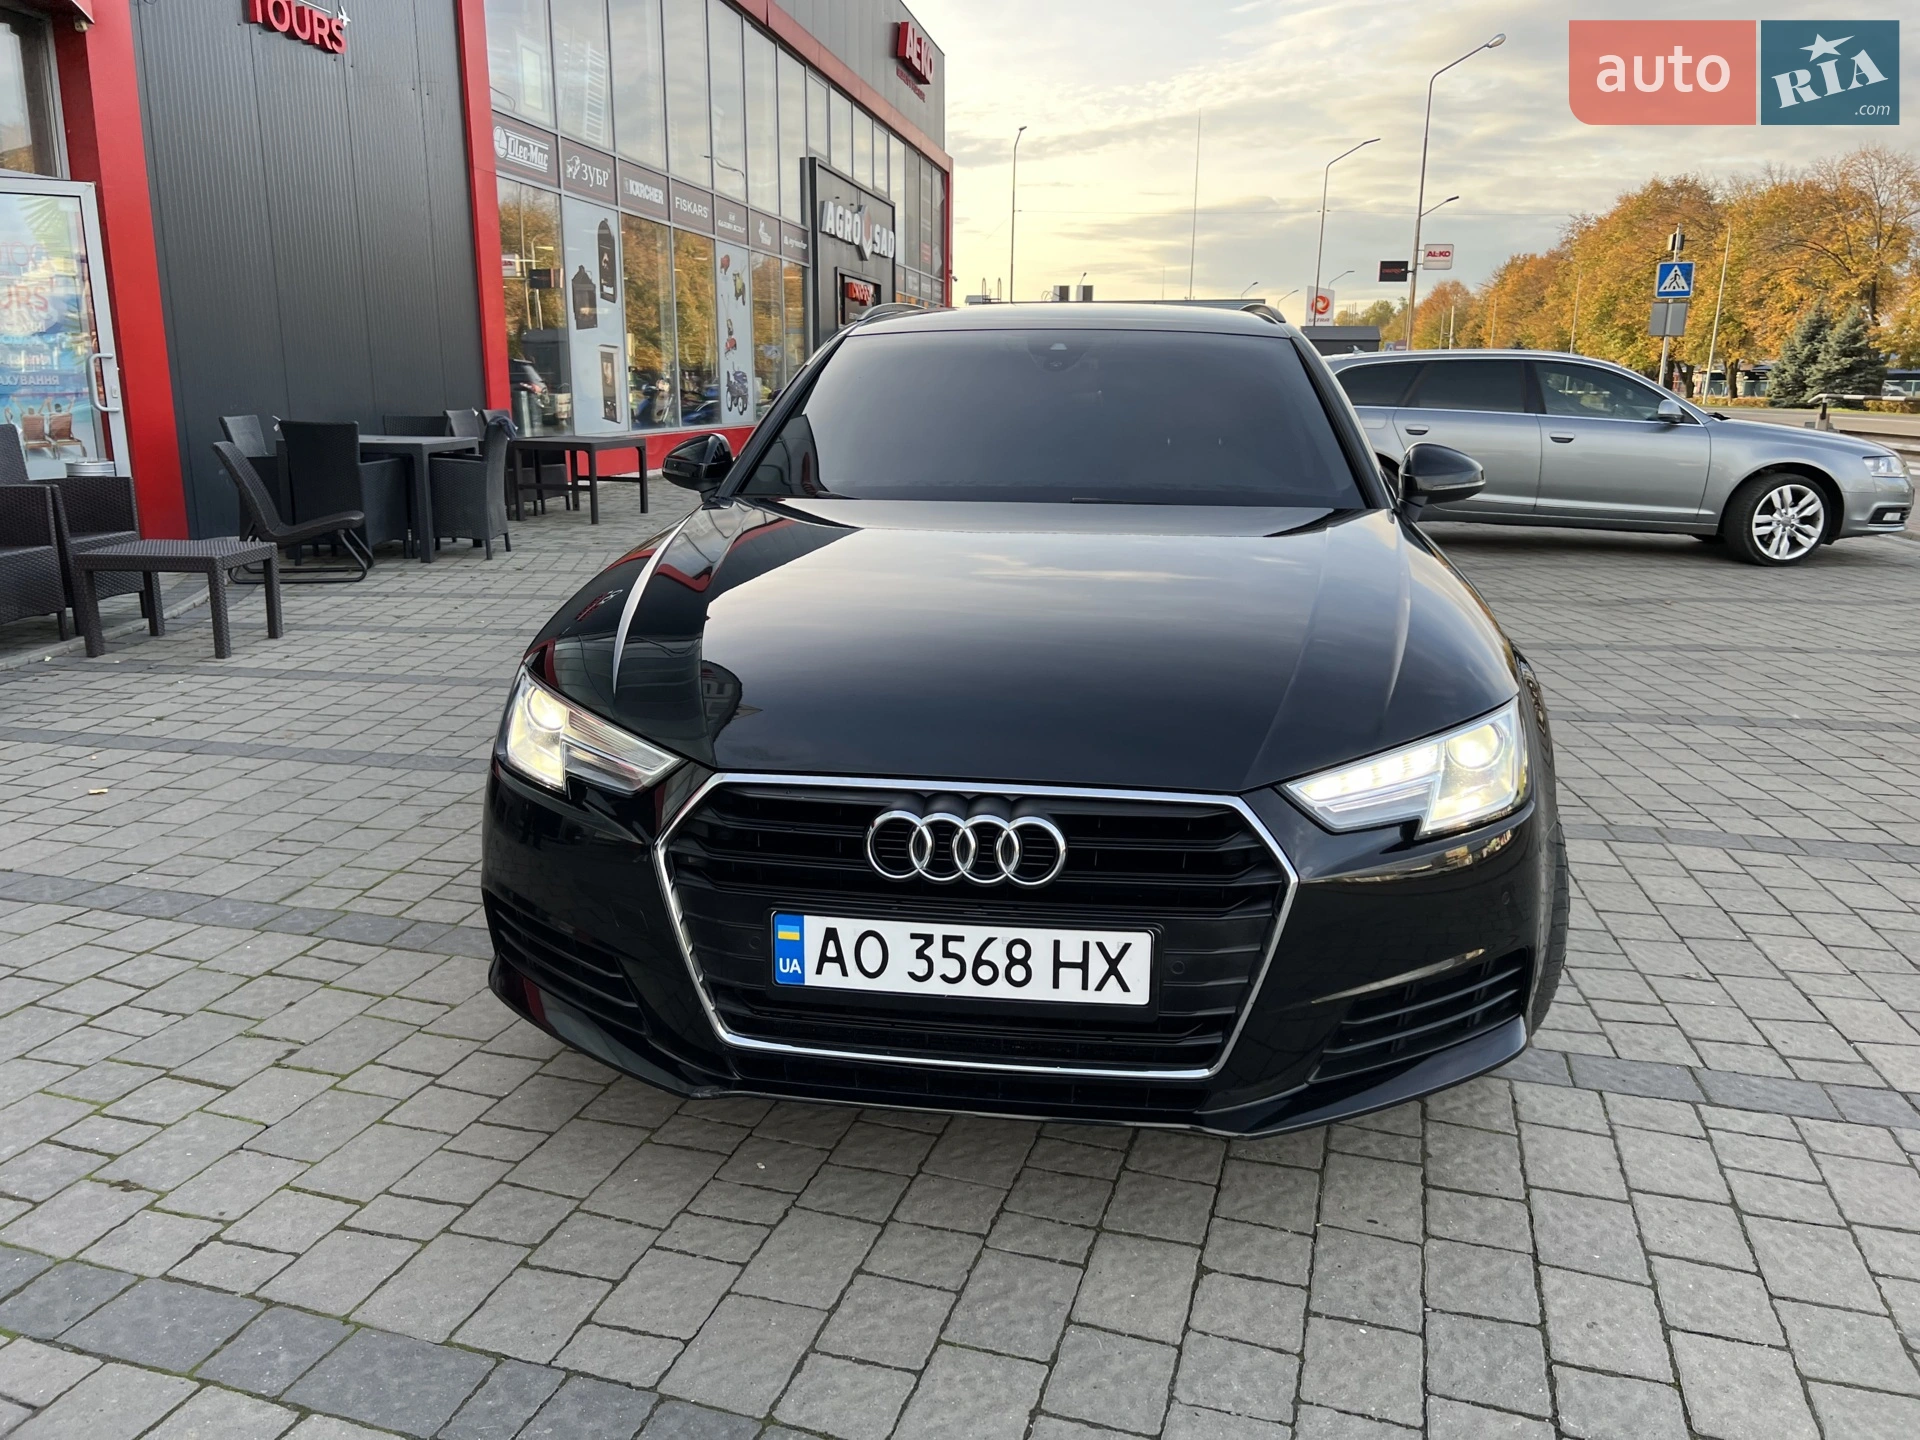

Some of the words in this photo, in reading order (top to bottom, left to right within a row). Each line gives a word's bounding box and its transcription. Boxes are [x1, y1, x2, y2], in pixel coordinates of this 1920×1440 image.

[250, 0, 347, 54] TOURS
[581, 163, 609, 188] ЗУБР
[675, 197, 709, 219] FISKARS
[822, 200, 862, 246] AGRO
[873, 223, 895, 259] SAD
[778, 957, 802, 974] UA
[907, 932, 1033, 988] 3568
